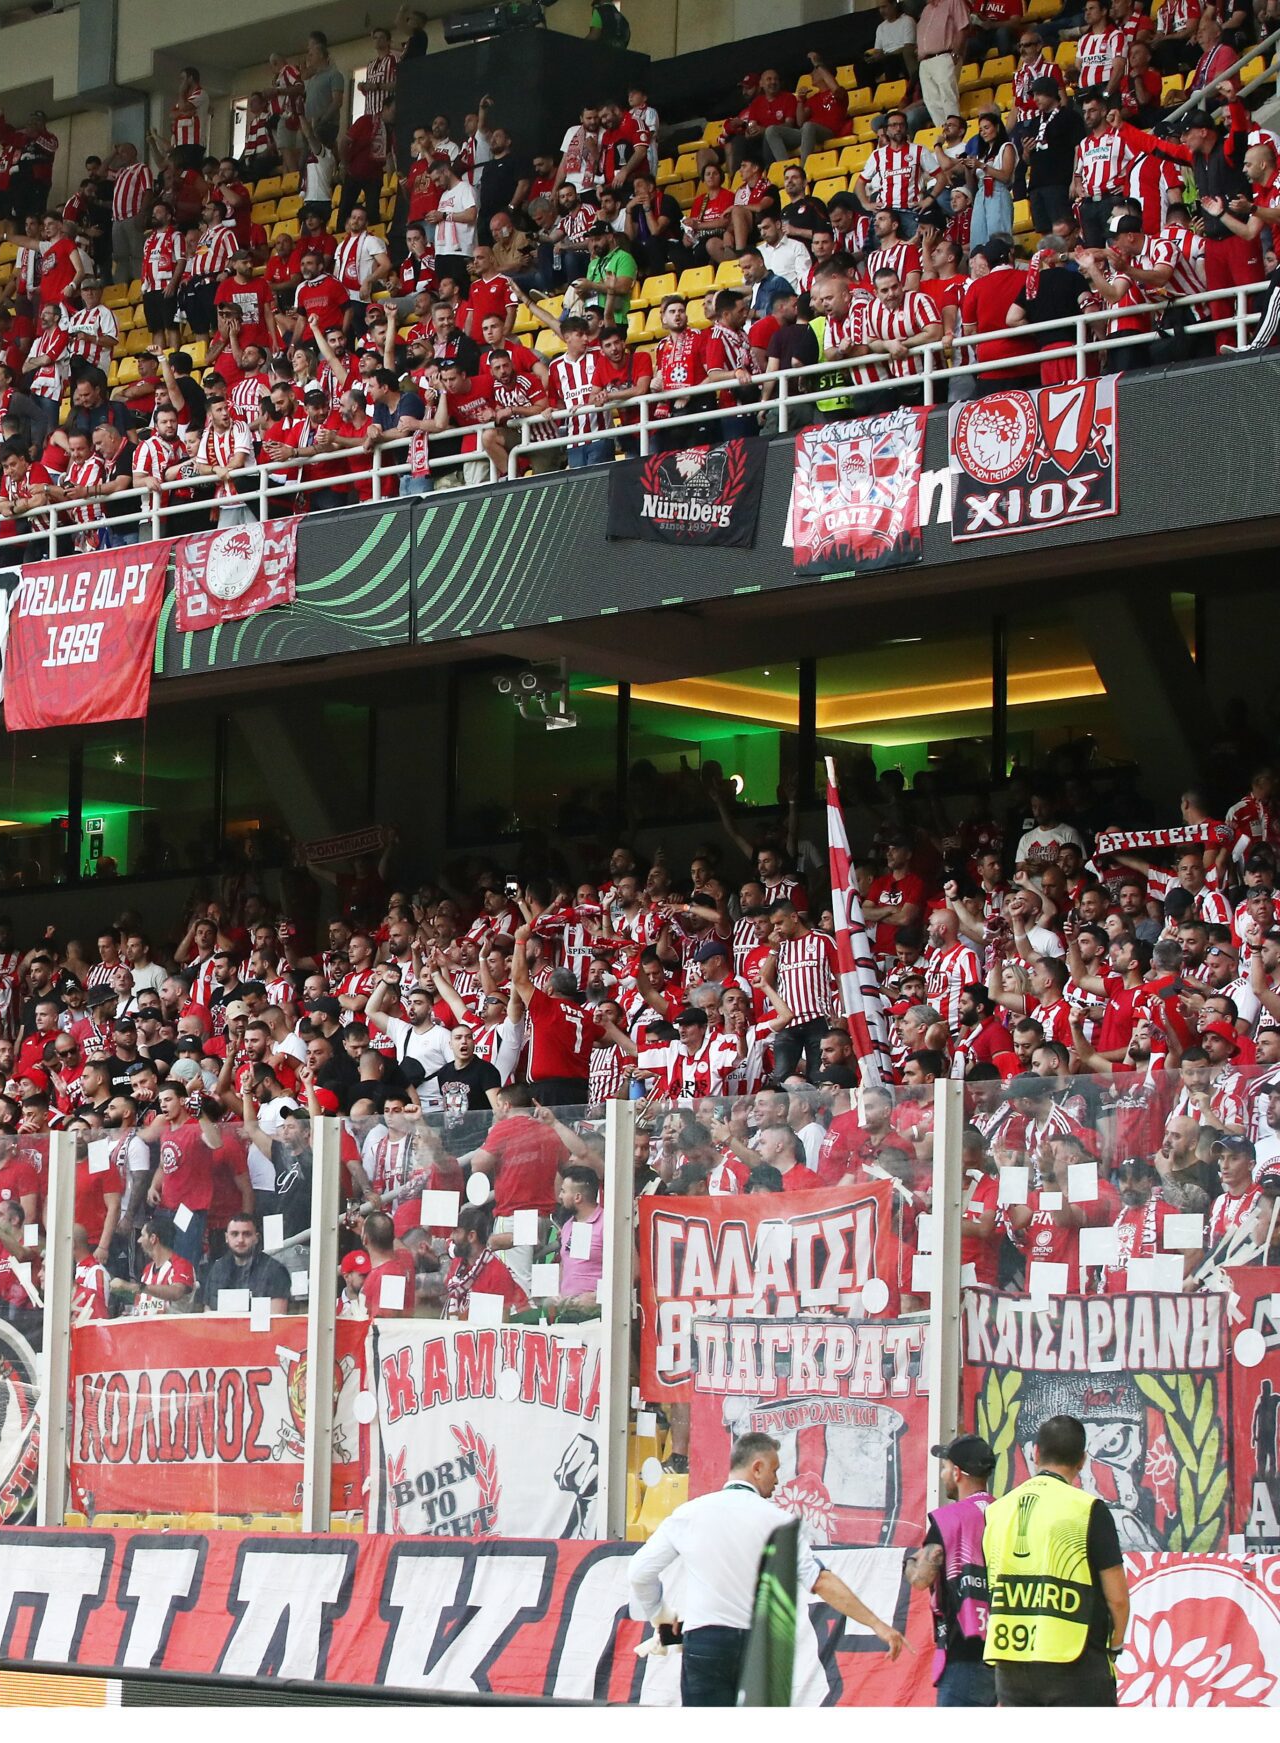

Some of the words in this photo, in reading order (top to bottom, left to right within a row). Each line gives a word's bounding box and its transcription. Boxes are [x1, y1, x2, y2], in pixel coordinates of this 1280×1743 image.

[1048, 385, 1086, 453] 7
[640, 494, 732, 528] Nürnberg
[825, 508, 867, 530] GATE
[966, 473, 1103, 531] ΧΙΟΣ
[687, 522, 712, 533] 1997
[19, 571, 93, 617] DELLE
[94, 563, 153, 610] ALPI
[41, 621, 104, 668] 1999
[565, 1014, 584, 1054] 7
[657, 1206, 872, 1298] ΓΑΛΑΤΣΙ
[79, 1367, 273, 1463] ΚΟΛΩΝΟΣ
[392, 1451, 477, 1507] BORN
[420, 1503, 494, 1537] GHT
[422, 1491, 456, 1525] TO
